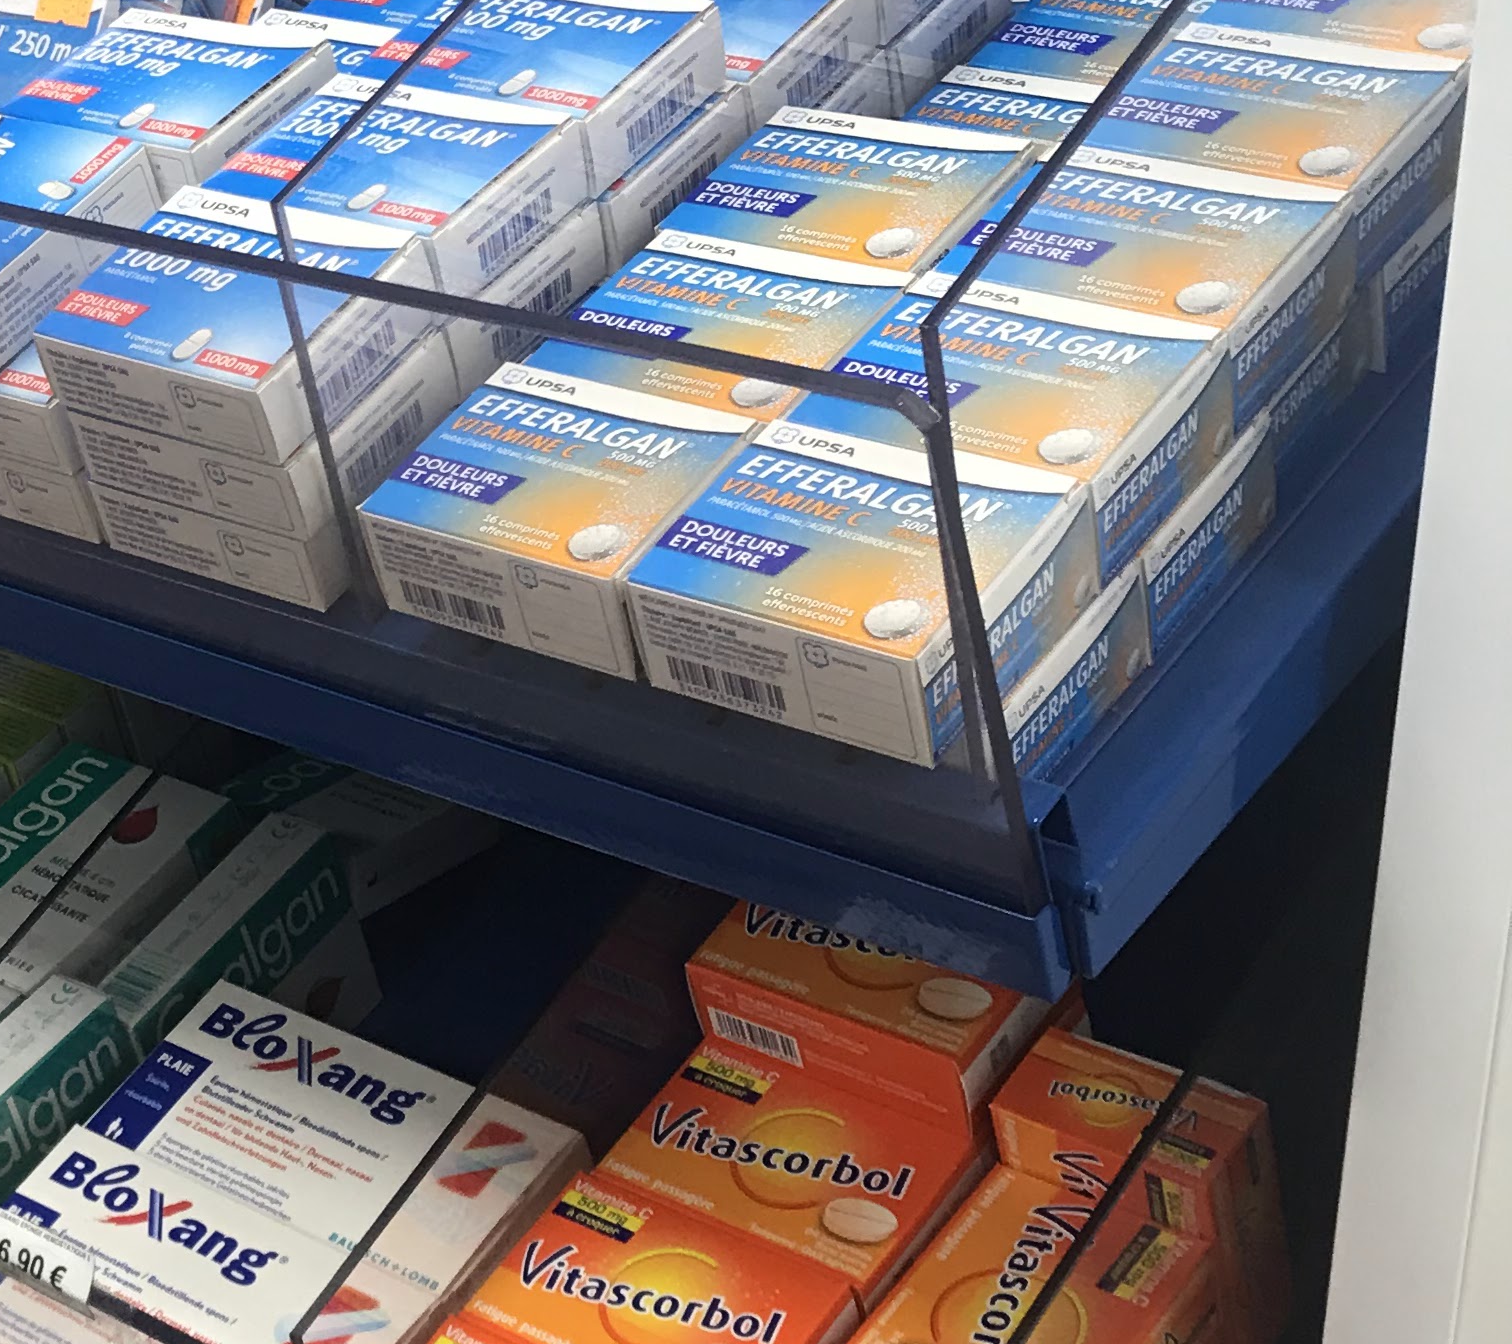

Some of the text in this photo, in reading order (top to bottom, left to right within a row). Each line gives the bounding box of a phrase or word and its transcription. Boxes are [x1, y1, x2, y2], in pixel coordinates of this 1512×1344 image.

[92, 32, 273, 69] EFFERALGAN
[1218, 32, 1273, 48] UPSA
[1149, 66, 1286, 95] VITAMINE C
[1162, 47, 1399, 94] EFFERALGAN
[201, 199, 250, 219] UPSA
[684, 239, 736, 257] UPSA
[188, 265, 238, 292] mg
[637, 257, 849, 310] EFFERALGAN
[63, 301, 122, 323] ET FIÈVRE
[71, 291, 138, 314] DOULEURS
[526, 376, 578, 397] UPSA
[450, 415, 586, 458] VITAMINE C
[474, 394, 687, 460] EFFERALGAN
[799, 433, 855, 457] UPSA
[1103, 408, 1199, 534] EFFERALGAN
[720, 478, 872, 527] VITAMINE C
[669, 534, 766, 568] ET FIÈVRE
[681, 521, 789, 558] DOULEURS
[1154, 484, 1244, 605] EFFERALGAN
[762, 598, 847, 627] effervescents
[765, 586, 854, 617] 16 comprimés
[157, 1052, 195, 1077] PLAIE
[198, 1002, 425, 1126] BloXang
[649, 1099, 916, 1200] Vitascorbol
[48, 1150, 278, 1286] BloXang
[49, 1265, 67, 1292] €
